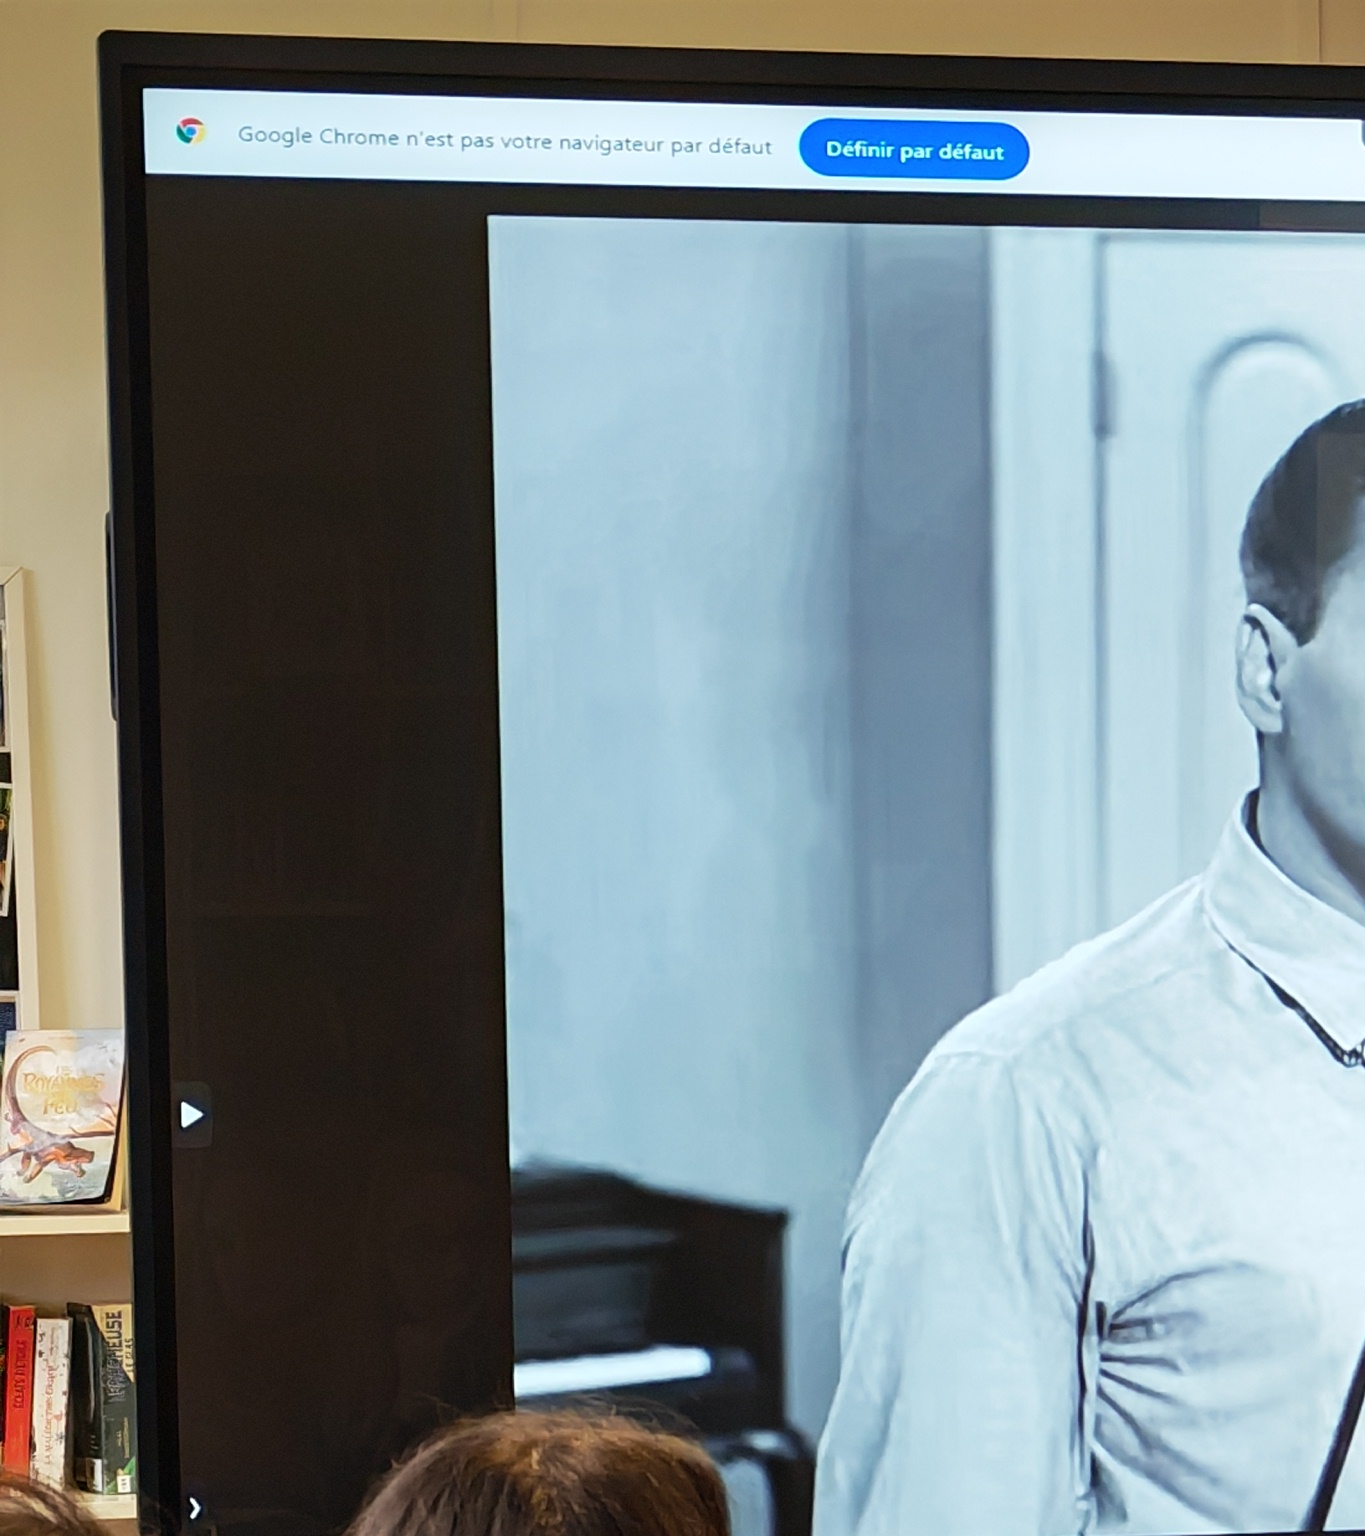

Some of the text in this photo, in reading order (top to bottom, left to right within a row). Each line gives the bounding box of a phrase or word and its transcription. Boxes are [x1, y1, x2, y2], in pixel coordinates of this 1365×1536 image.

[238, 126, 772, 157] Google Chrome n'est pas votre navigateur par défaut
[826, 140, 1005, 164] Définir par défaut
